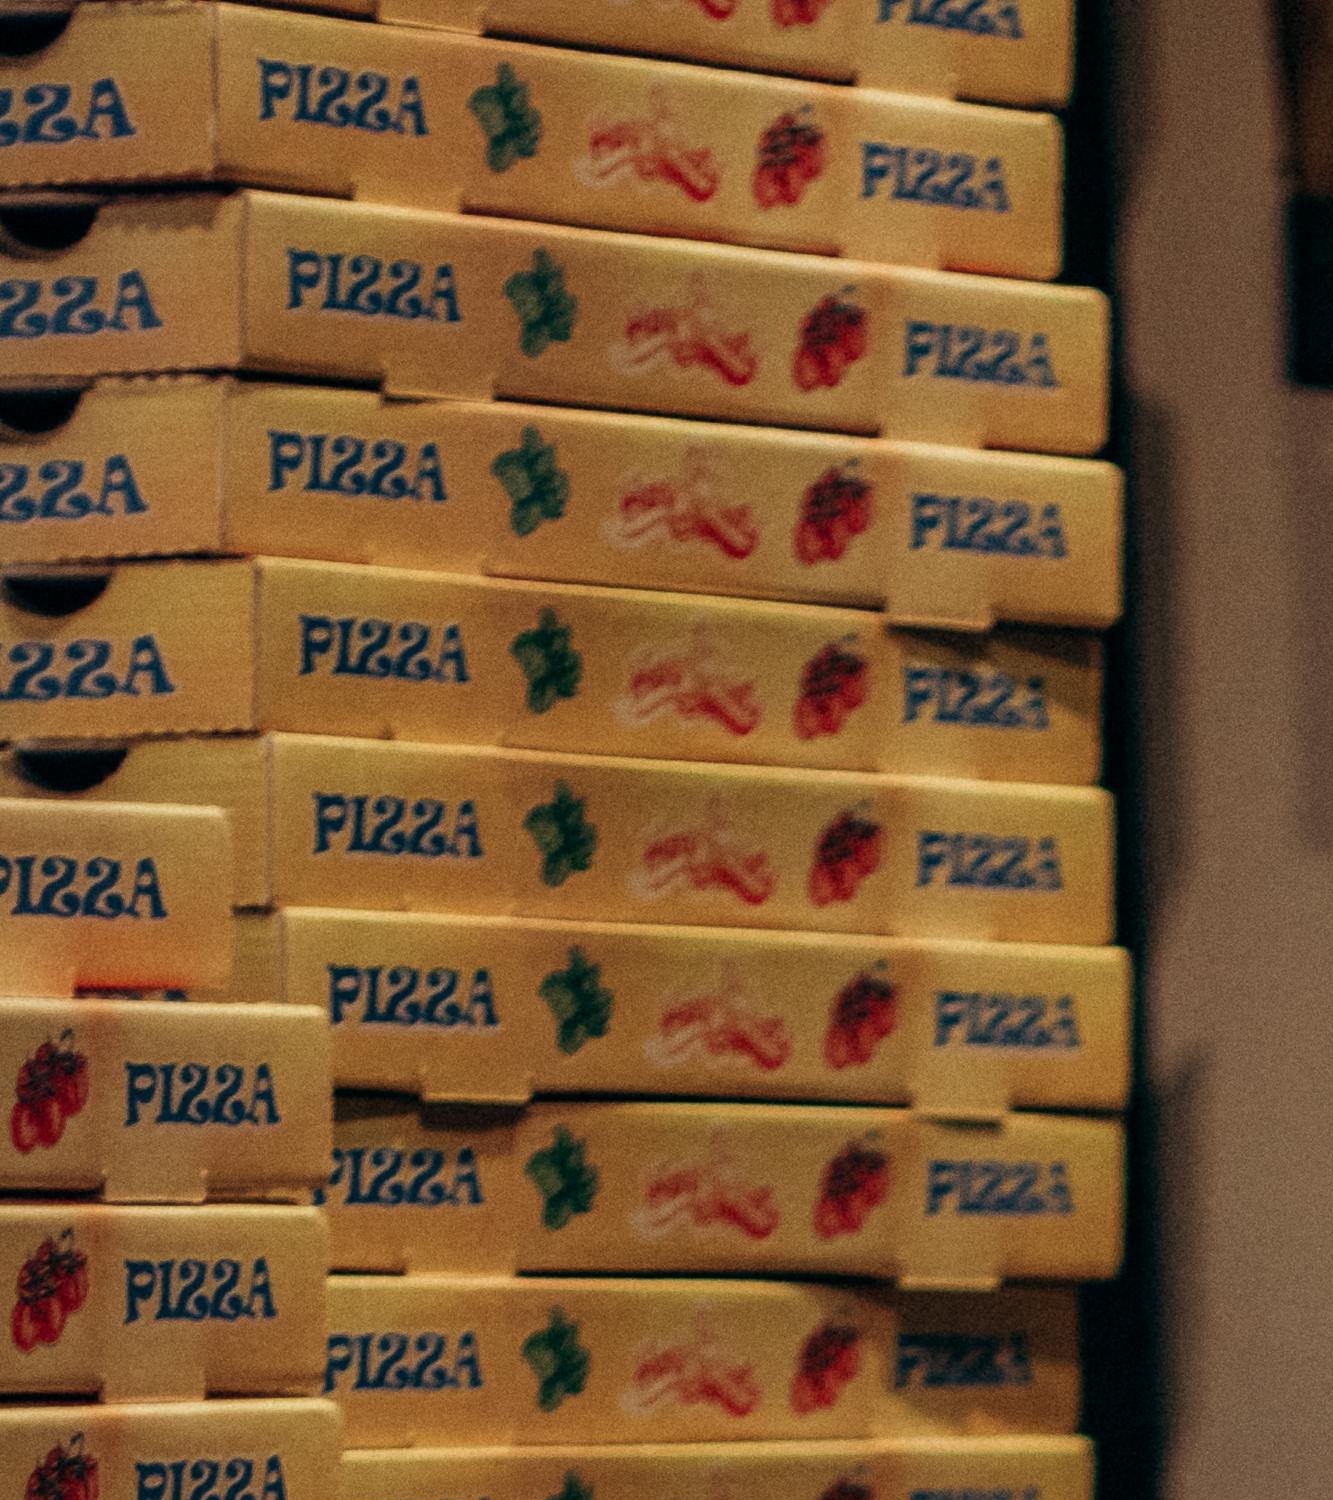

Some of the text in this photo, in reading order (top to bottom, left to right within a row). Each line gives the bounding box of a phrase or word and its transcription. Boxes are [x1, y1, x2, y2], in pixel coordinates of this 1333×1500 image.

[260, 60, 428, 136] PIZZA
[861, 141, 1010, 212] PIZZA
[0, 272, 161, 339] ZZA
[288, 250, 461, 323] PIZZA
[904, 321, 1055, 388] PIZZA
[0, 456, 146, 521] ZZA
[270, 432, 447, 502] PIZZA
[911, 493, 1065, 558] PIZZA
[0, 637, 173, 701] ZZA
[301, 616, 468, 682] PIZZA
[904, 667, 1048, 729] PIZZA
[315, 795, 482, 857] PIZZA
[917, 831, 1058, 891] PIZZA
[329, 967, 497, 1026] PIZZA
[935, 991, 1075, 1050] PIZZA
[126, 1064, 280, 1125] PIZZA
[926, 1160, 1071, 1215] PIZZA
[125, 1260, 276, 1321] PIZZA
[323, 1333, 483, 1392] PIZZA
